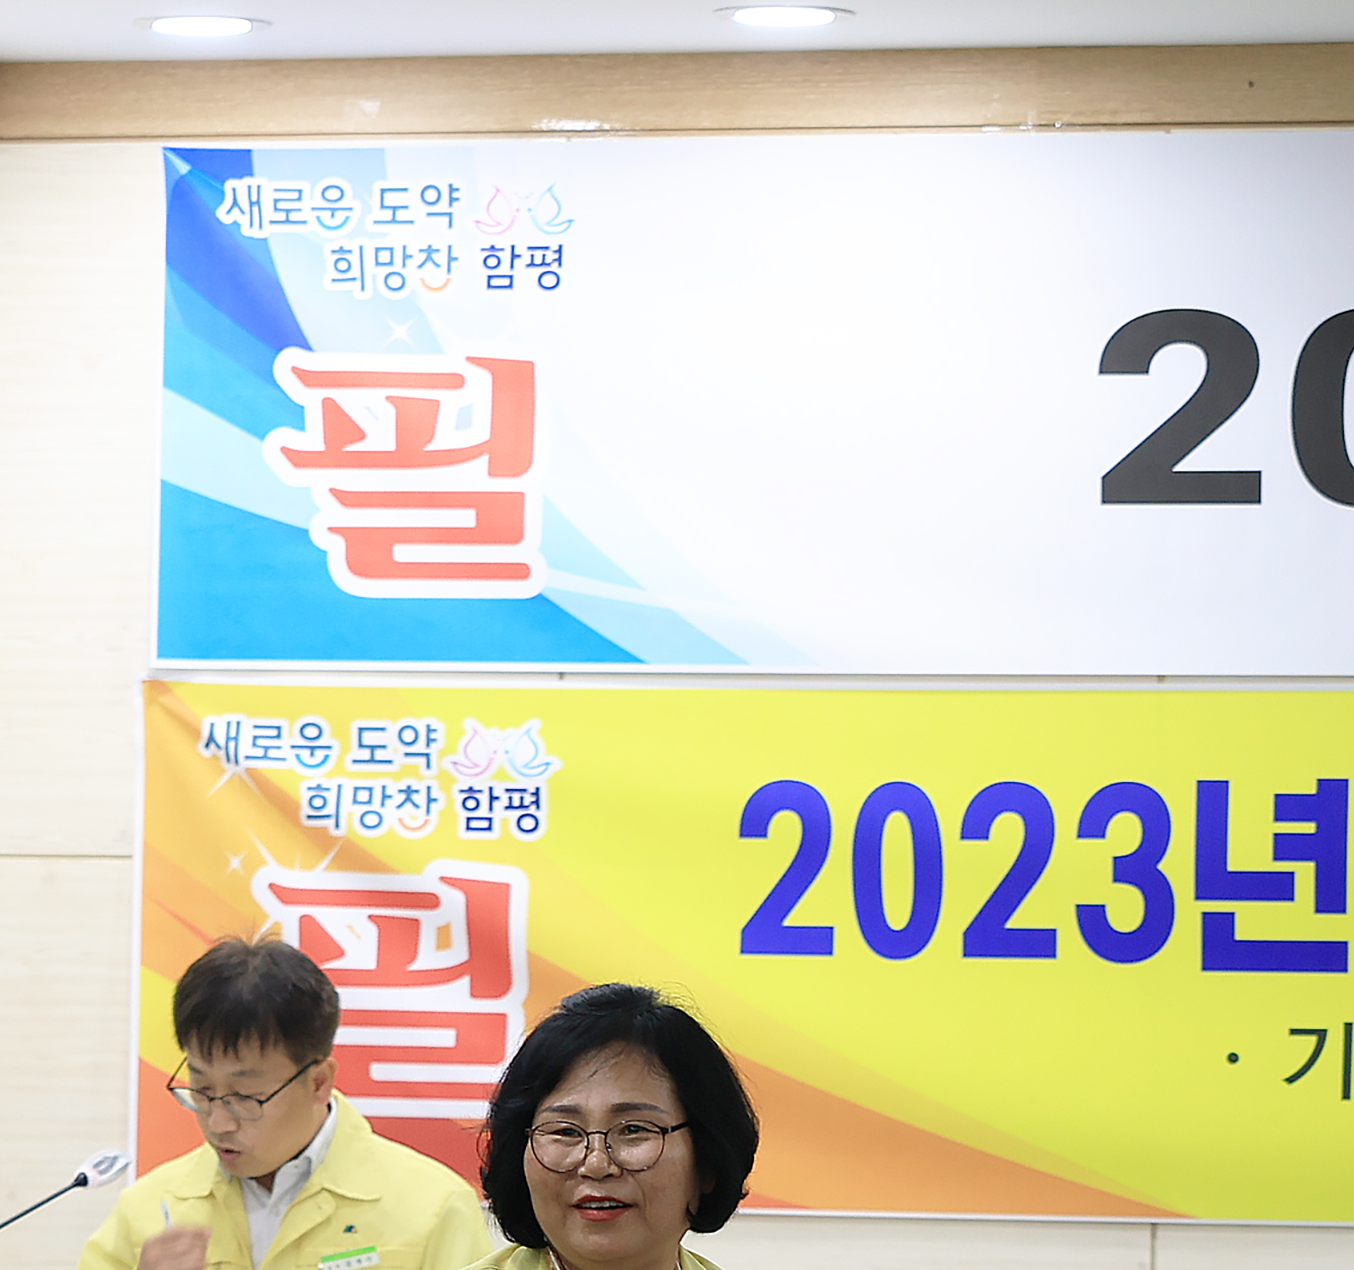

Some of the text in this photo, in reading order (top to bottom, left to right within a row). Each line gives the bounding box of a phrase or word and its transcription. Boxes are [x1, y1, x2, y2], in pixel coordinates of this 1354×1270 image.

[222, 183, 460, 231] 새로운 도약
[331, 244, 563, 291] 희망찬 함평
[280, 356, 536, 581] 필
[204, 721, 437, 769] 새로운 도약
[306, 784, 540, 833] 희망찬 함평
[739, 779, 1349, 973] 2023년
